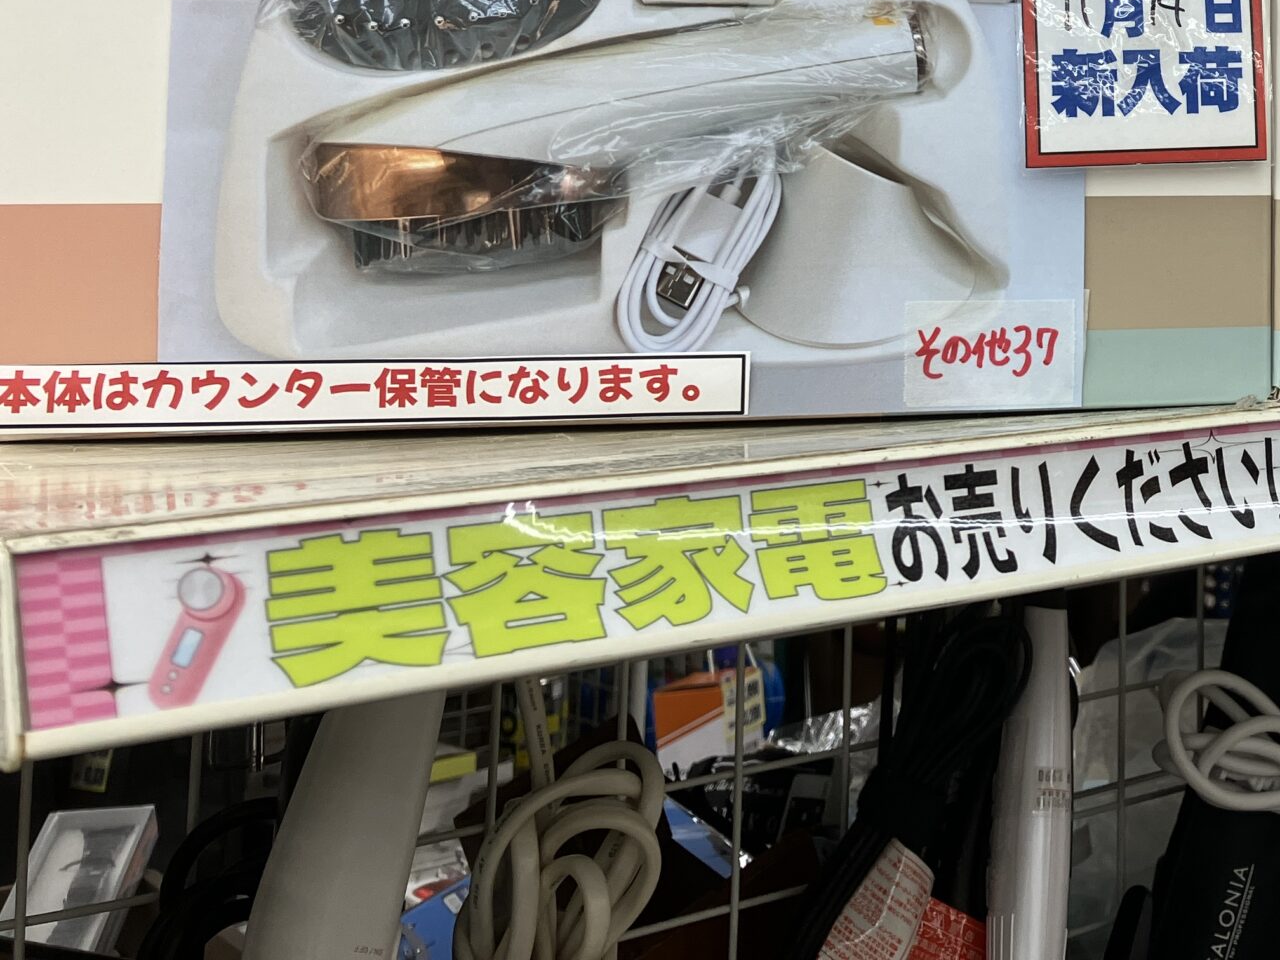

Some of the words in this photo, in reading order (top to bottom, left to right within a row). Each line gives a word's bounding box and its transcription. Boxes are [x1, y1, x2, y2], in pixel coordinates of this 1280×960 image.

[1051, 49, 1243, 118] 新入荷
[0, 364, 703, 414] 本体はカウンター保管になります。
[1205, 867, 1249, 960] ALONIA
